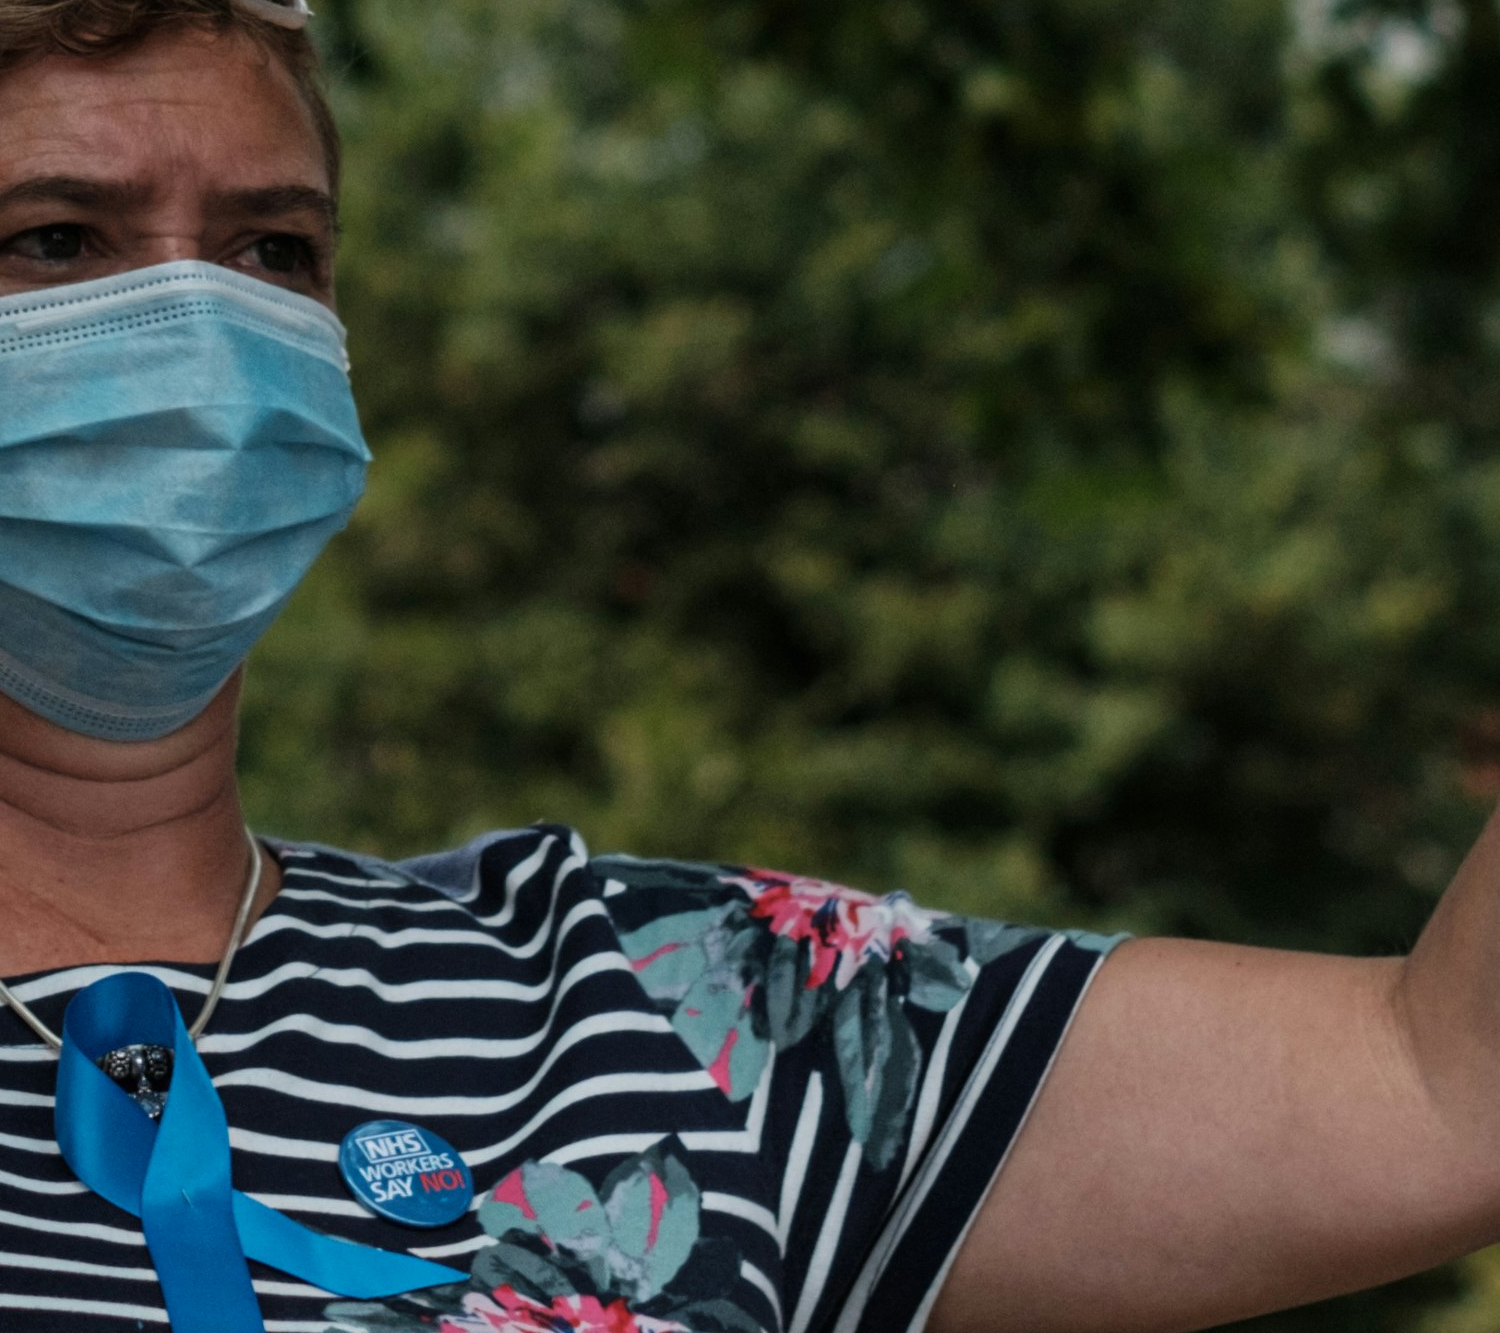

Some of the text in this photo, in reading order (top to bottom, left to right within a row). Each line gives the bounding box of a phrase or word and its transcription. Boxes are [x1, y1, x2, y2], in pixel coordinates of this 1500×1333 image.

[363, 1132, 423, 1160] NHS
[358, 1152, 455, 1183] WORKERS
[369, 1168, 466, 1203] SAY NO!
